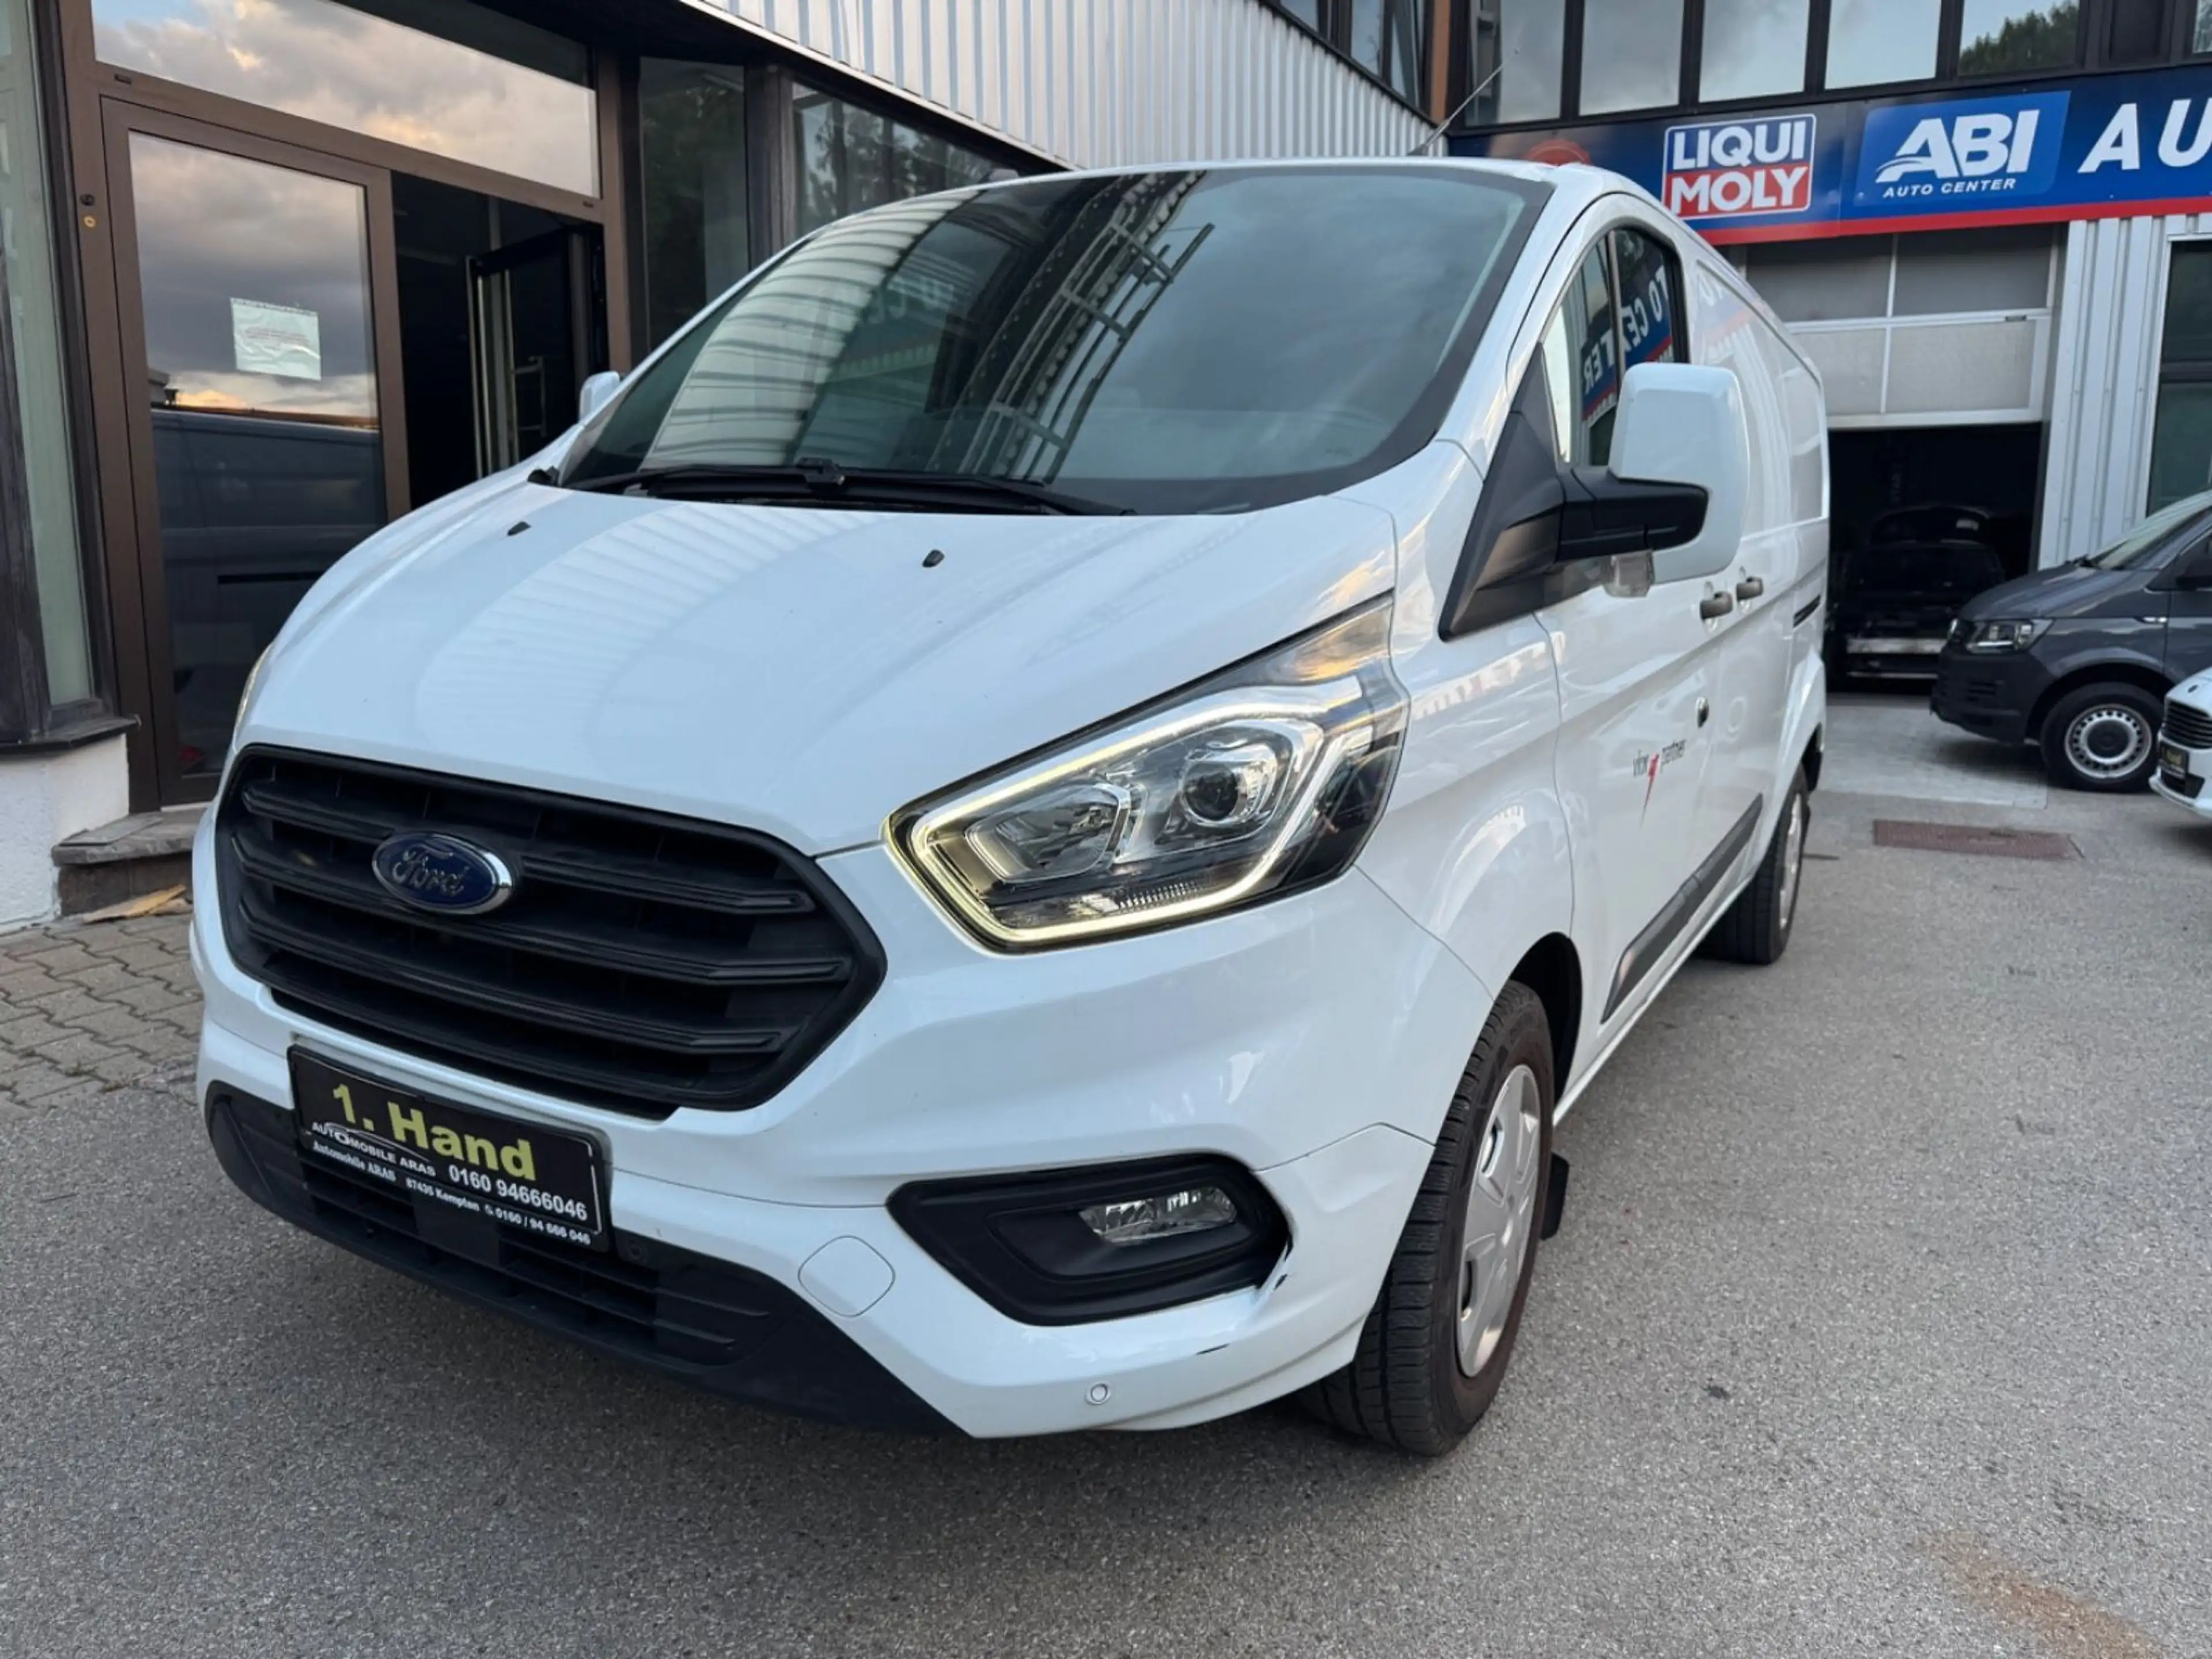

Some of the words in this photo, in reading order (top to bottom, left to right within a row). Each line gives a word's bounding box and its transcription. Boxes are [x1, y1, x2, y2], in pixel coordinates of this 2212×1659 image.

[1673, 120, 1806, 169] LIQUI
[1876, 109, 2040, 183] ABI
[1671, 166, 1808, 214] MOLY
[1882, 184, 1933, 199] AUTO
[1941, 178, 2016, 194] CENTER
[332, 1083, 374, 1132] 1.
[387, 1101, 536, 1181] Hand
[312, 1122, 397, 1165] AUTOMOBILE
[400, 1157, 436, 1177] ARAS
[448, 1164, 491, 1192] 0160
[496, 1179, 588, 1221] 94666046
[366, 1161, 397, 1182] ARAS
[435, 1187, 481, 1213] Kempten
